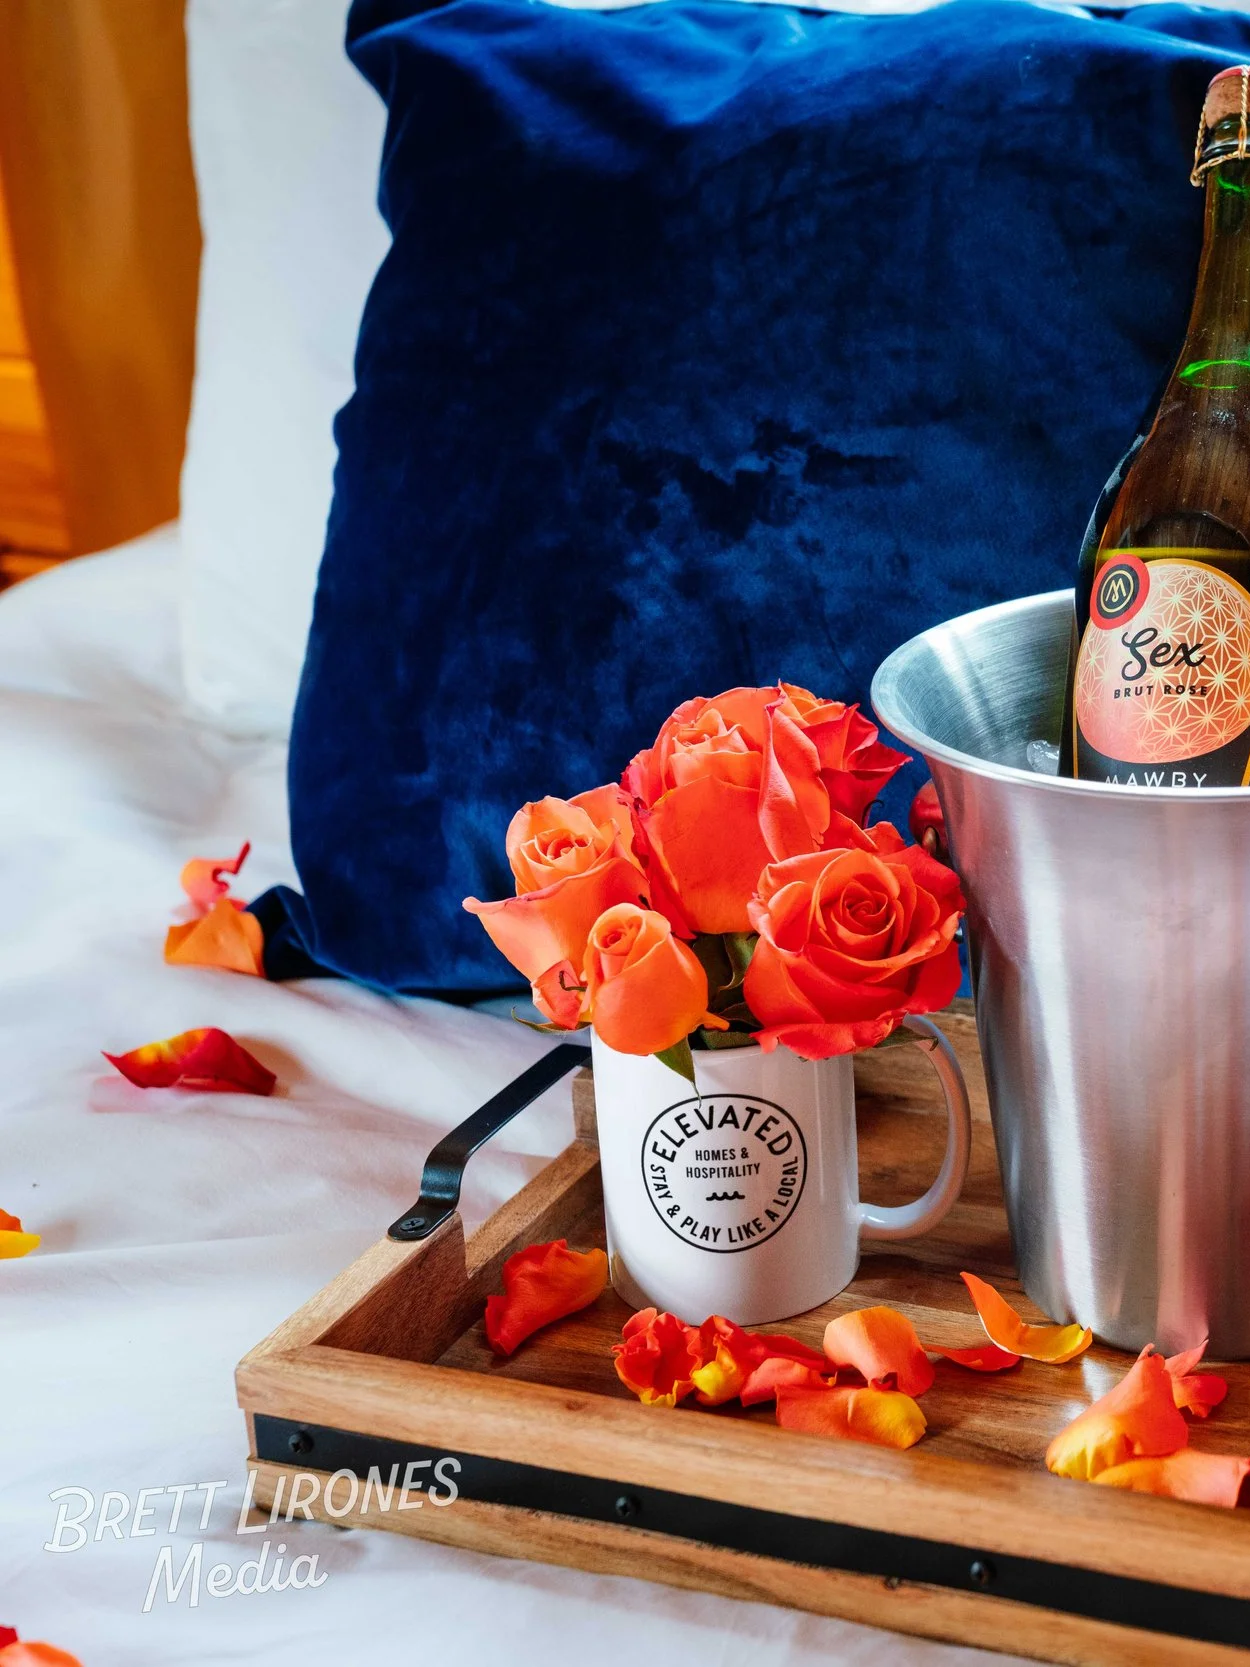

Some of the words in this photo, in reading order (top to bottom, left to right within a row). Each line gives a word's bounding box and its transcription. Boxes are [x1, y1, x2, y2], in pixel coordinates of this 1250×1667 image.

[1121, 627, 1206, 682] Sex
[1113, 684, 1154, 699] BRUT
[1163, 684, 1208, 697] ROSE
[1104, 771, 1208, 788] MAWBY
[651, 1105, 793, 1163] ELEVATED
[695, 1149, 736, 1161] HOMES
[740, 1147, 749, 1159] &
[686, 1163, 761, 1179] HOSPITALITY
[651, 1164, 673, 1200] STAY
[666, 1204, 681, 1218] &
[680, 1216, 721, 1243] PLAY
[728, 1217, 766, 1243] LIKE
[764, 1208, 780, 1222] A
[773, 1156, 798, 1207] LOCAL
